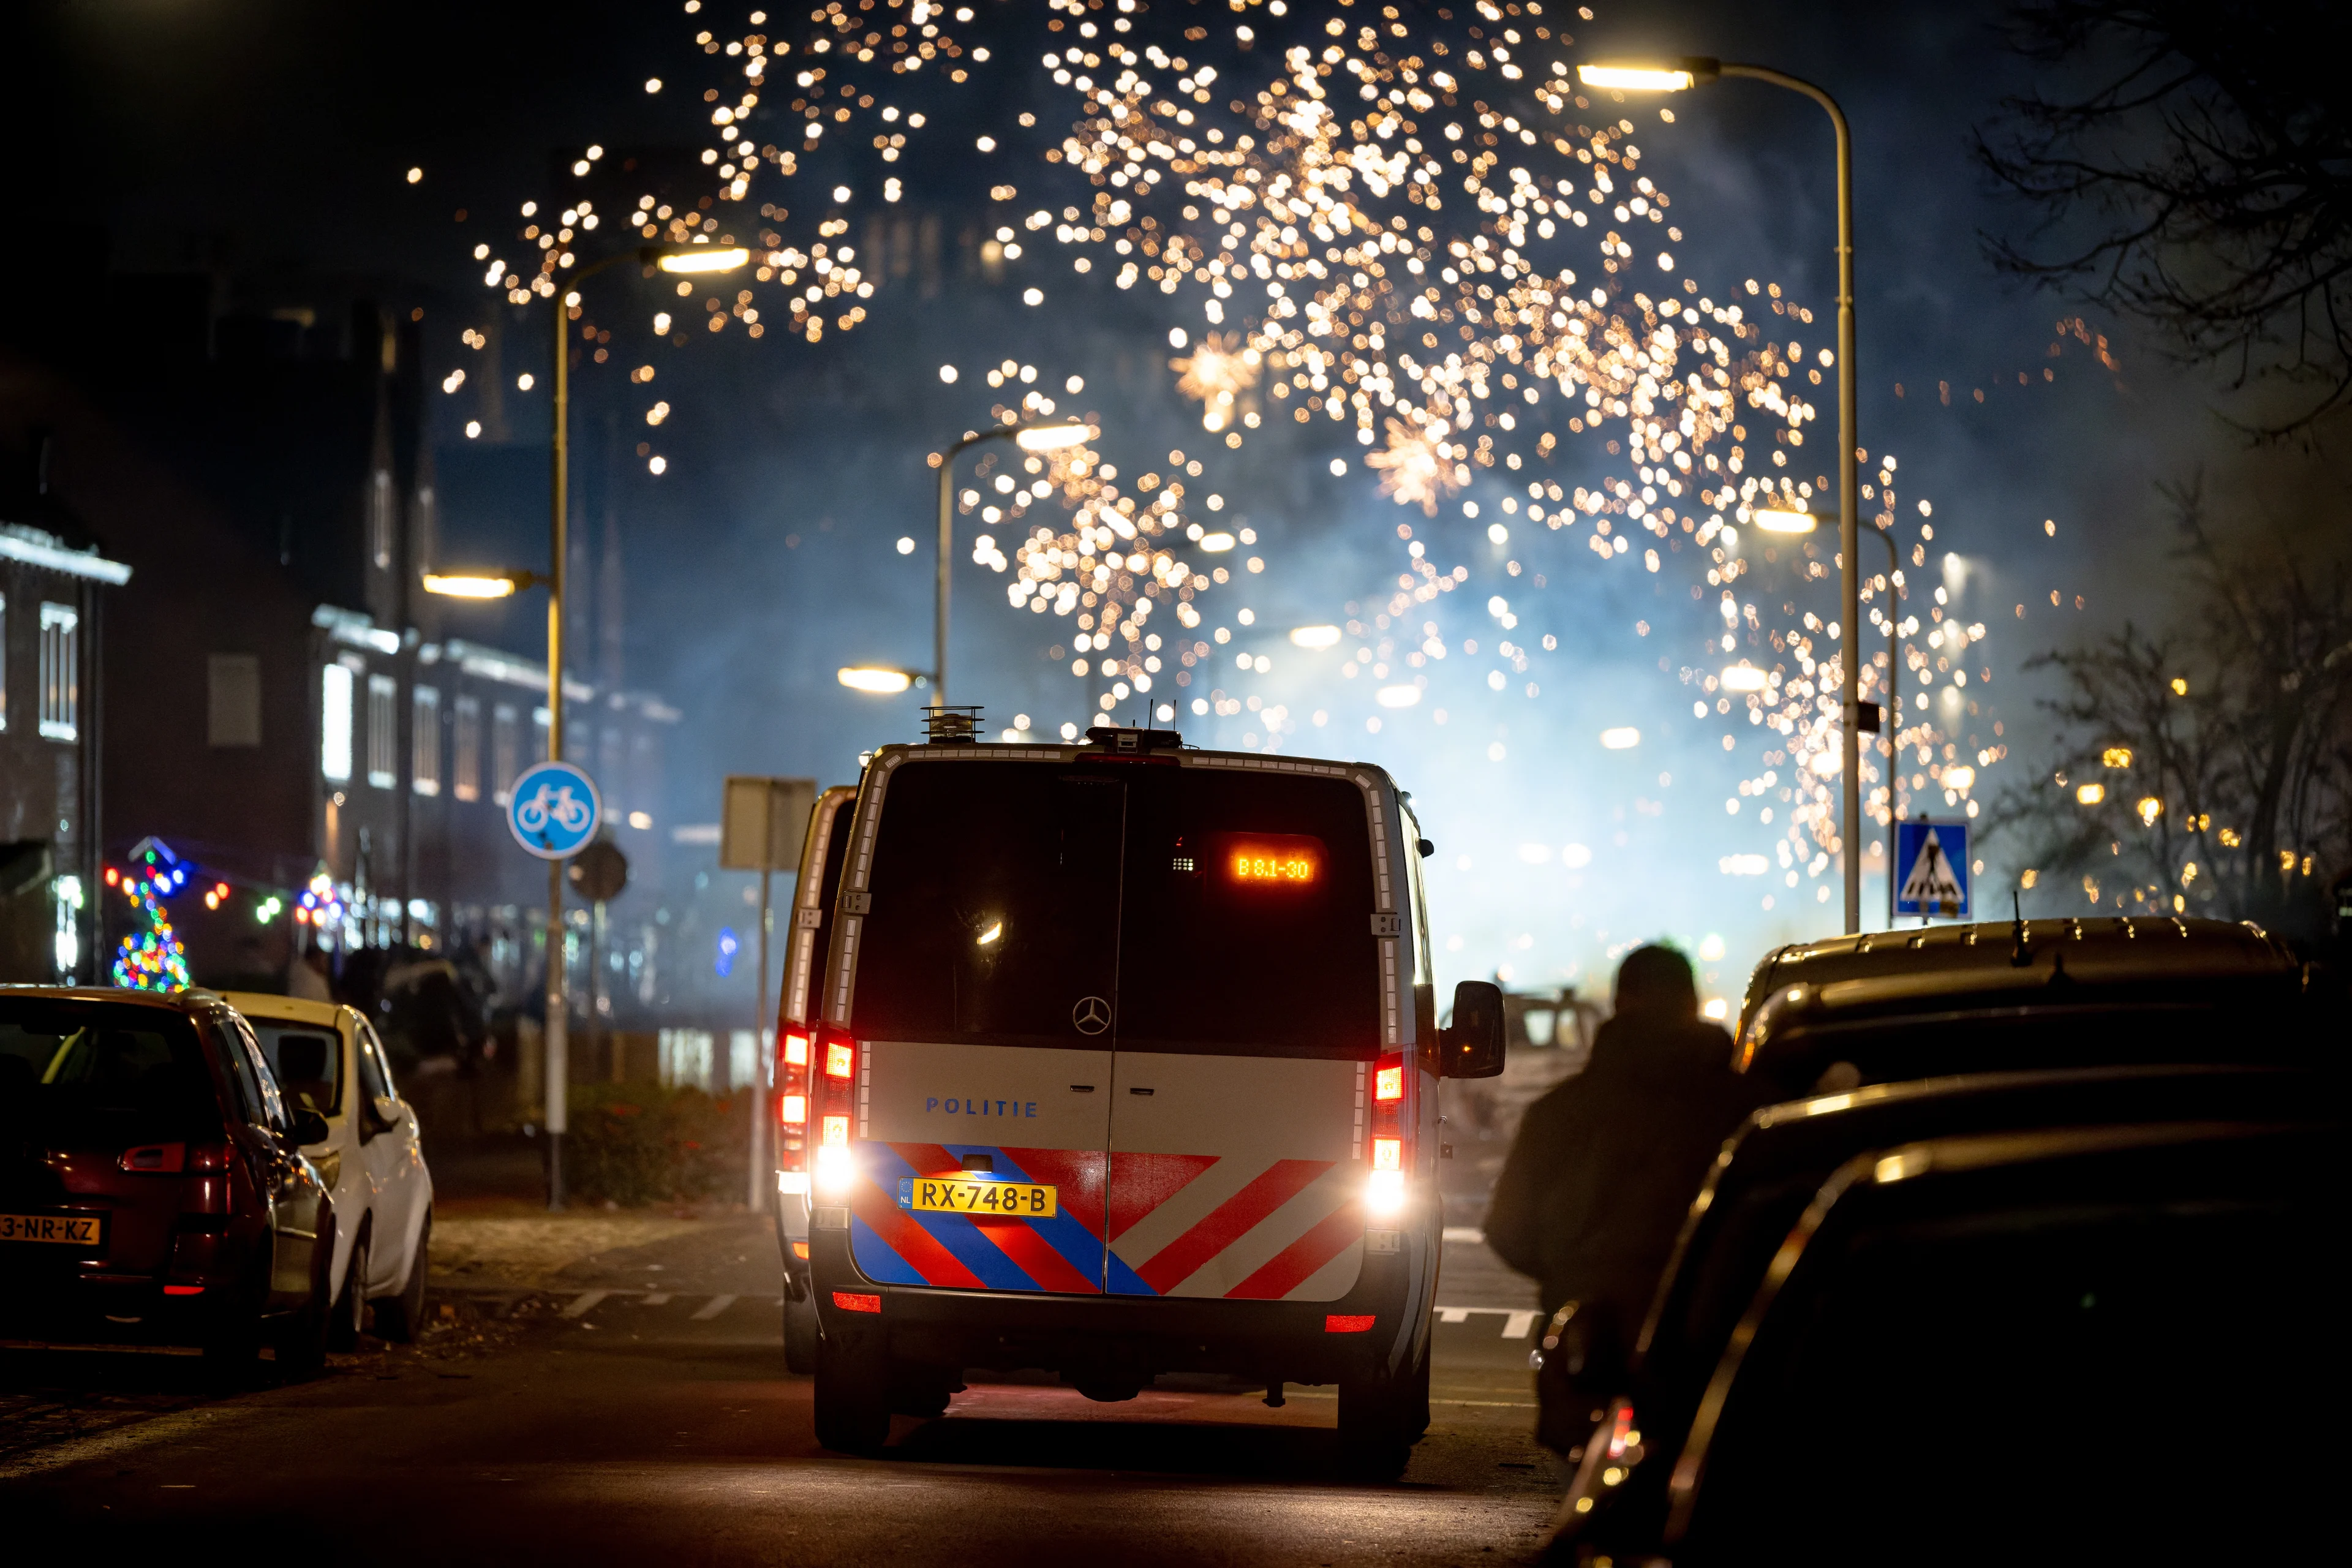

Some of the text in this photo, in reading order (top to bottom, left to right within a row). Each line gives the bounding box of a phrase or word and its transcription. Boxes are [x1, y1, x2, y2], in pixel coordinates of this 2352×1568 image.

[1238, 859, 1308, 878] B 8.1-30
[926, 1097, 1037, 1118] POLITIE
[922, 1183, 1046, 1212] RX-748-B
[0, 1217, 93, 1241] 3-NR-KZ
